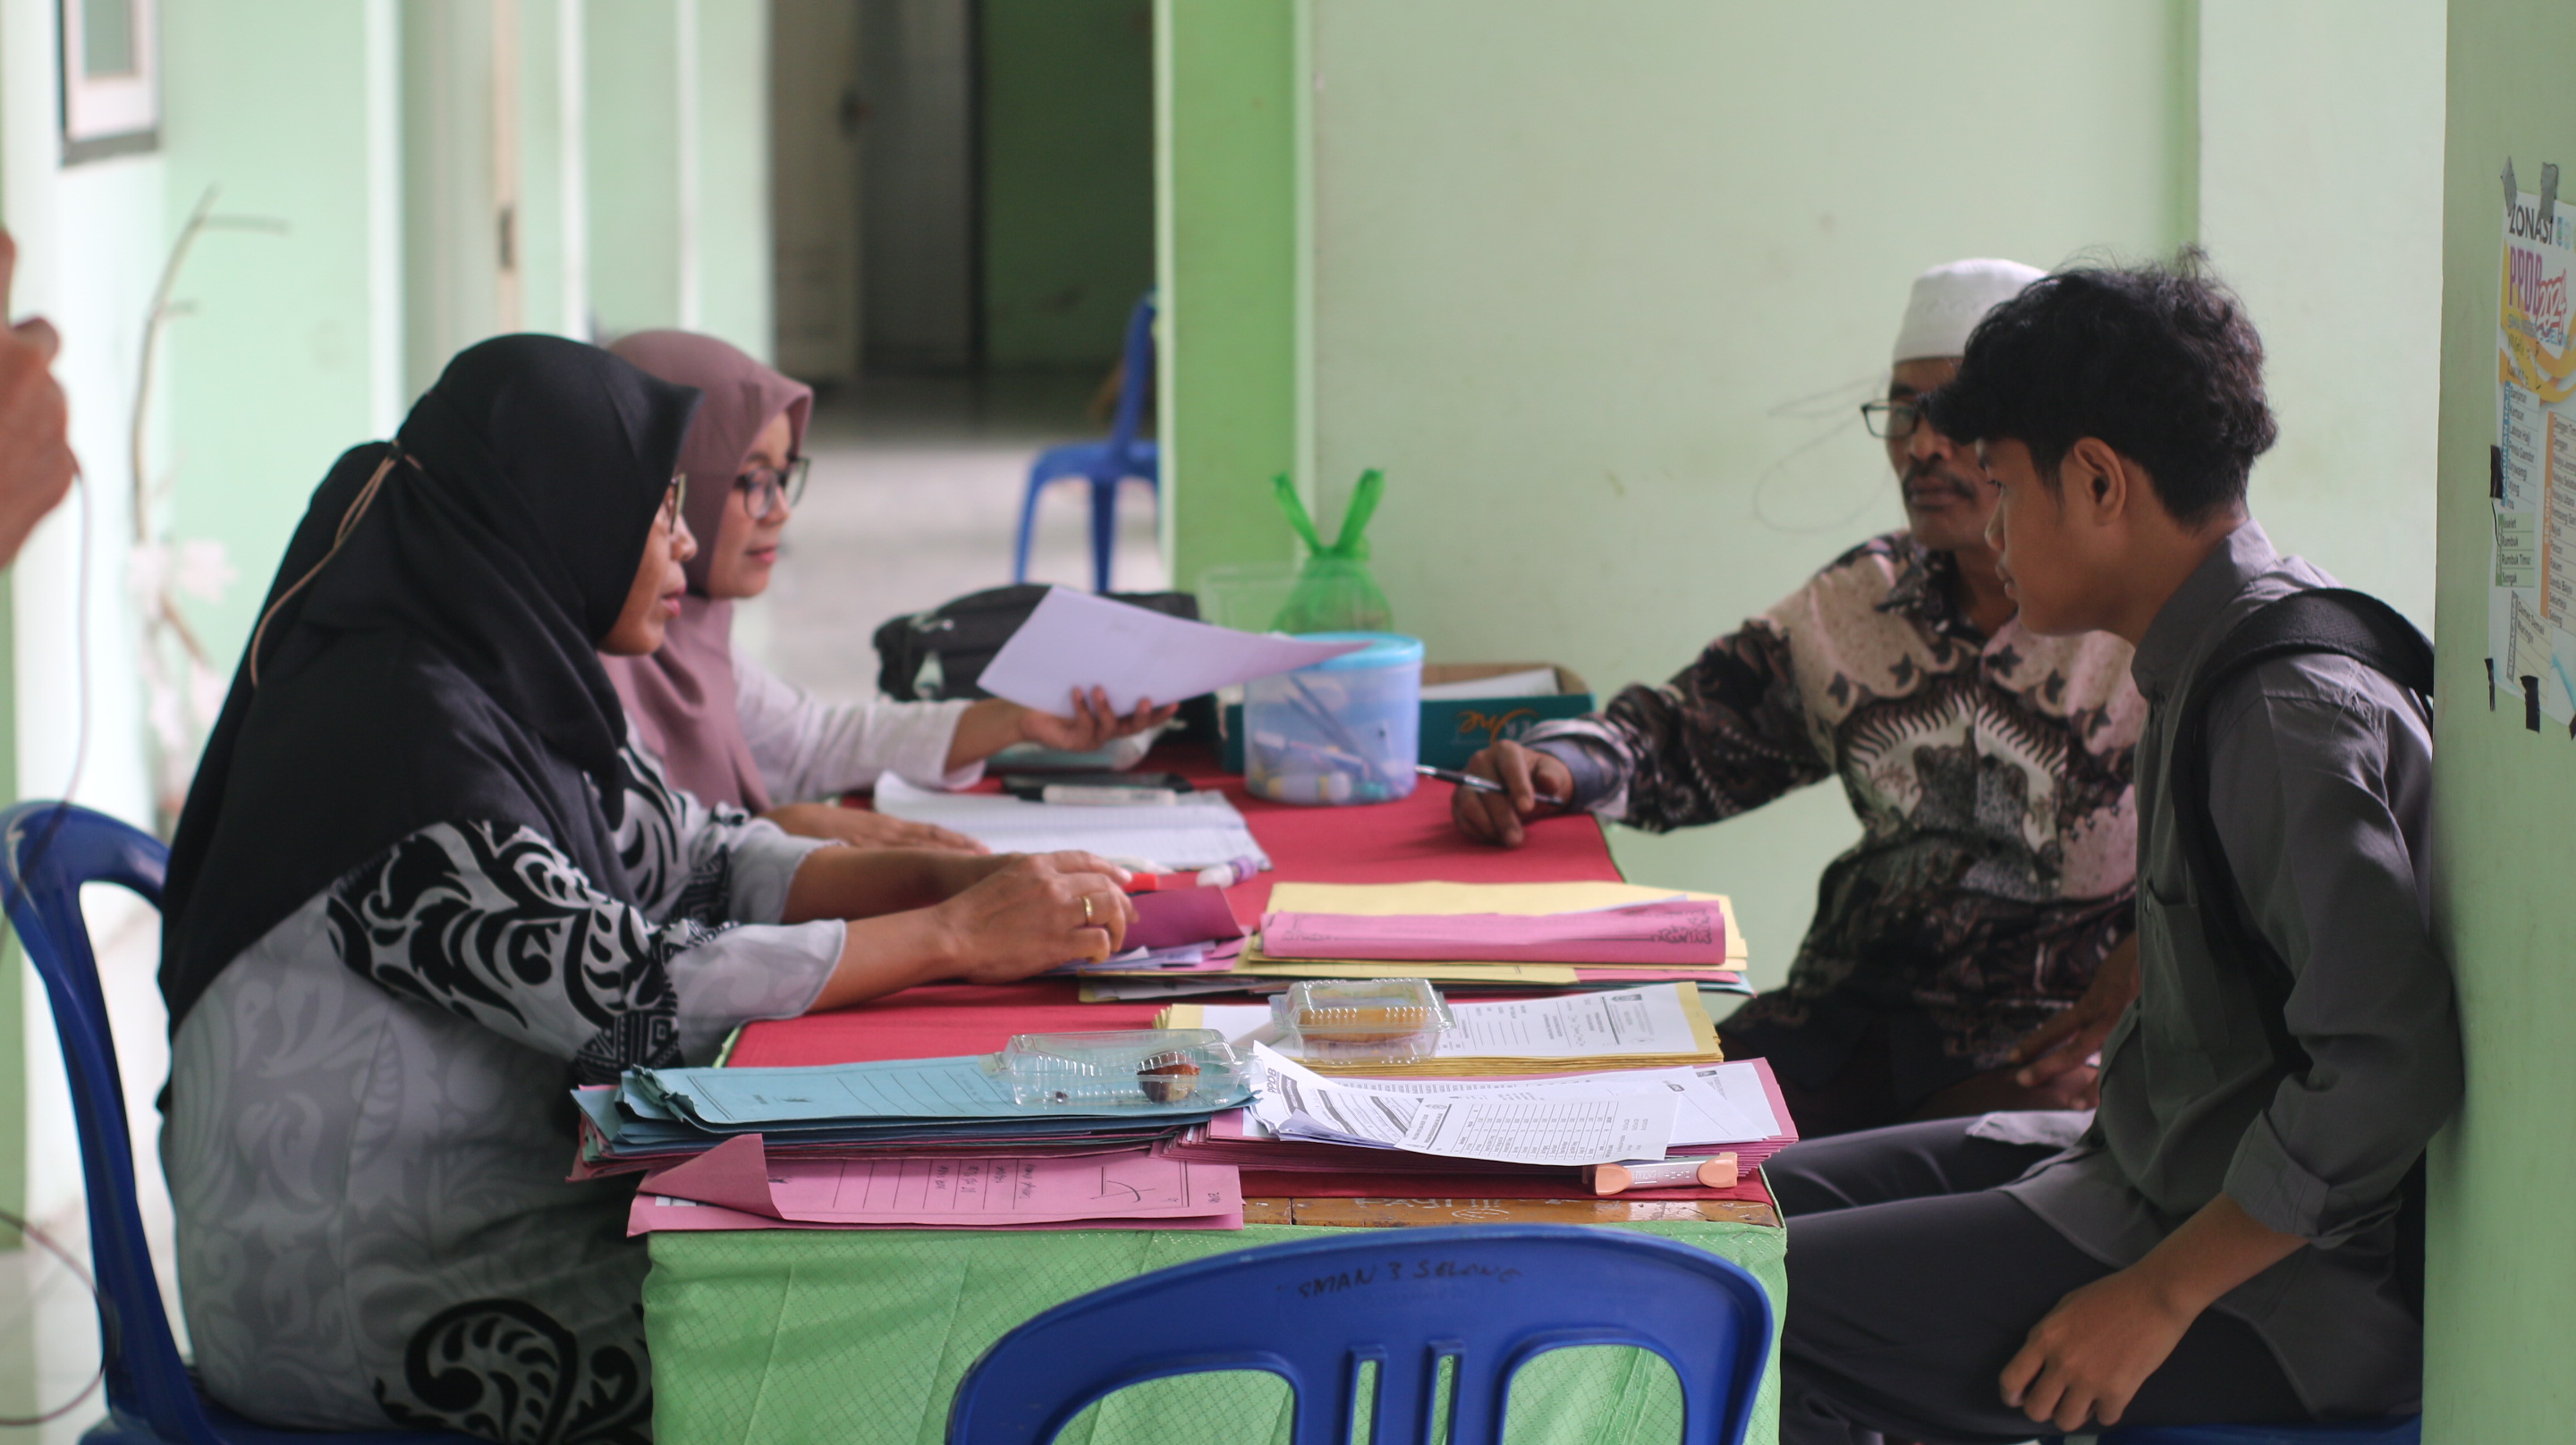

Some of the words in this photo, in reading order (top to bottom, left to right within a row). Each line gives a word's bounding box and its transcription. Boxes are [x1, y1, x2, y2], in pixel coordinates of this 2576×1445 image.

[2509, 204, 2554, 246] ZONASI
[2509, 245, 2543, 316] PPDB
[2535, 268, 2567, 343] 2024
[2507, 597, 2517, 676] SURALAGA
[1299, 1264, 1377, 1298] SMAN
[1388, 1262, 1402, 1280] 3
